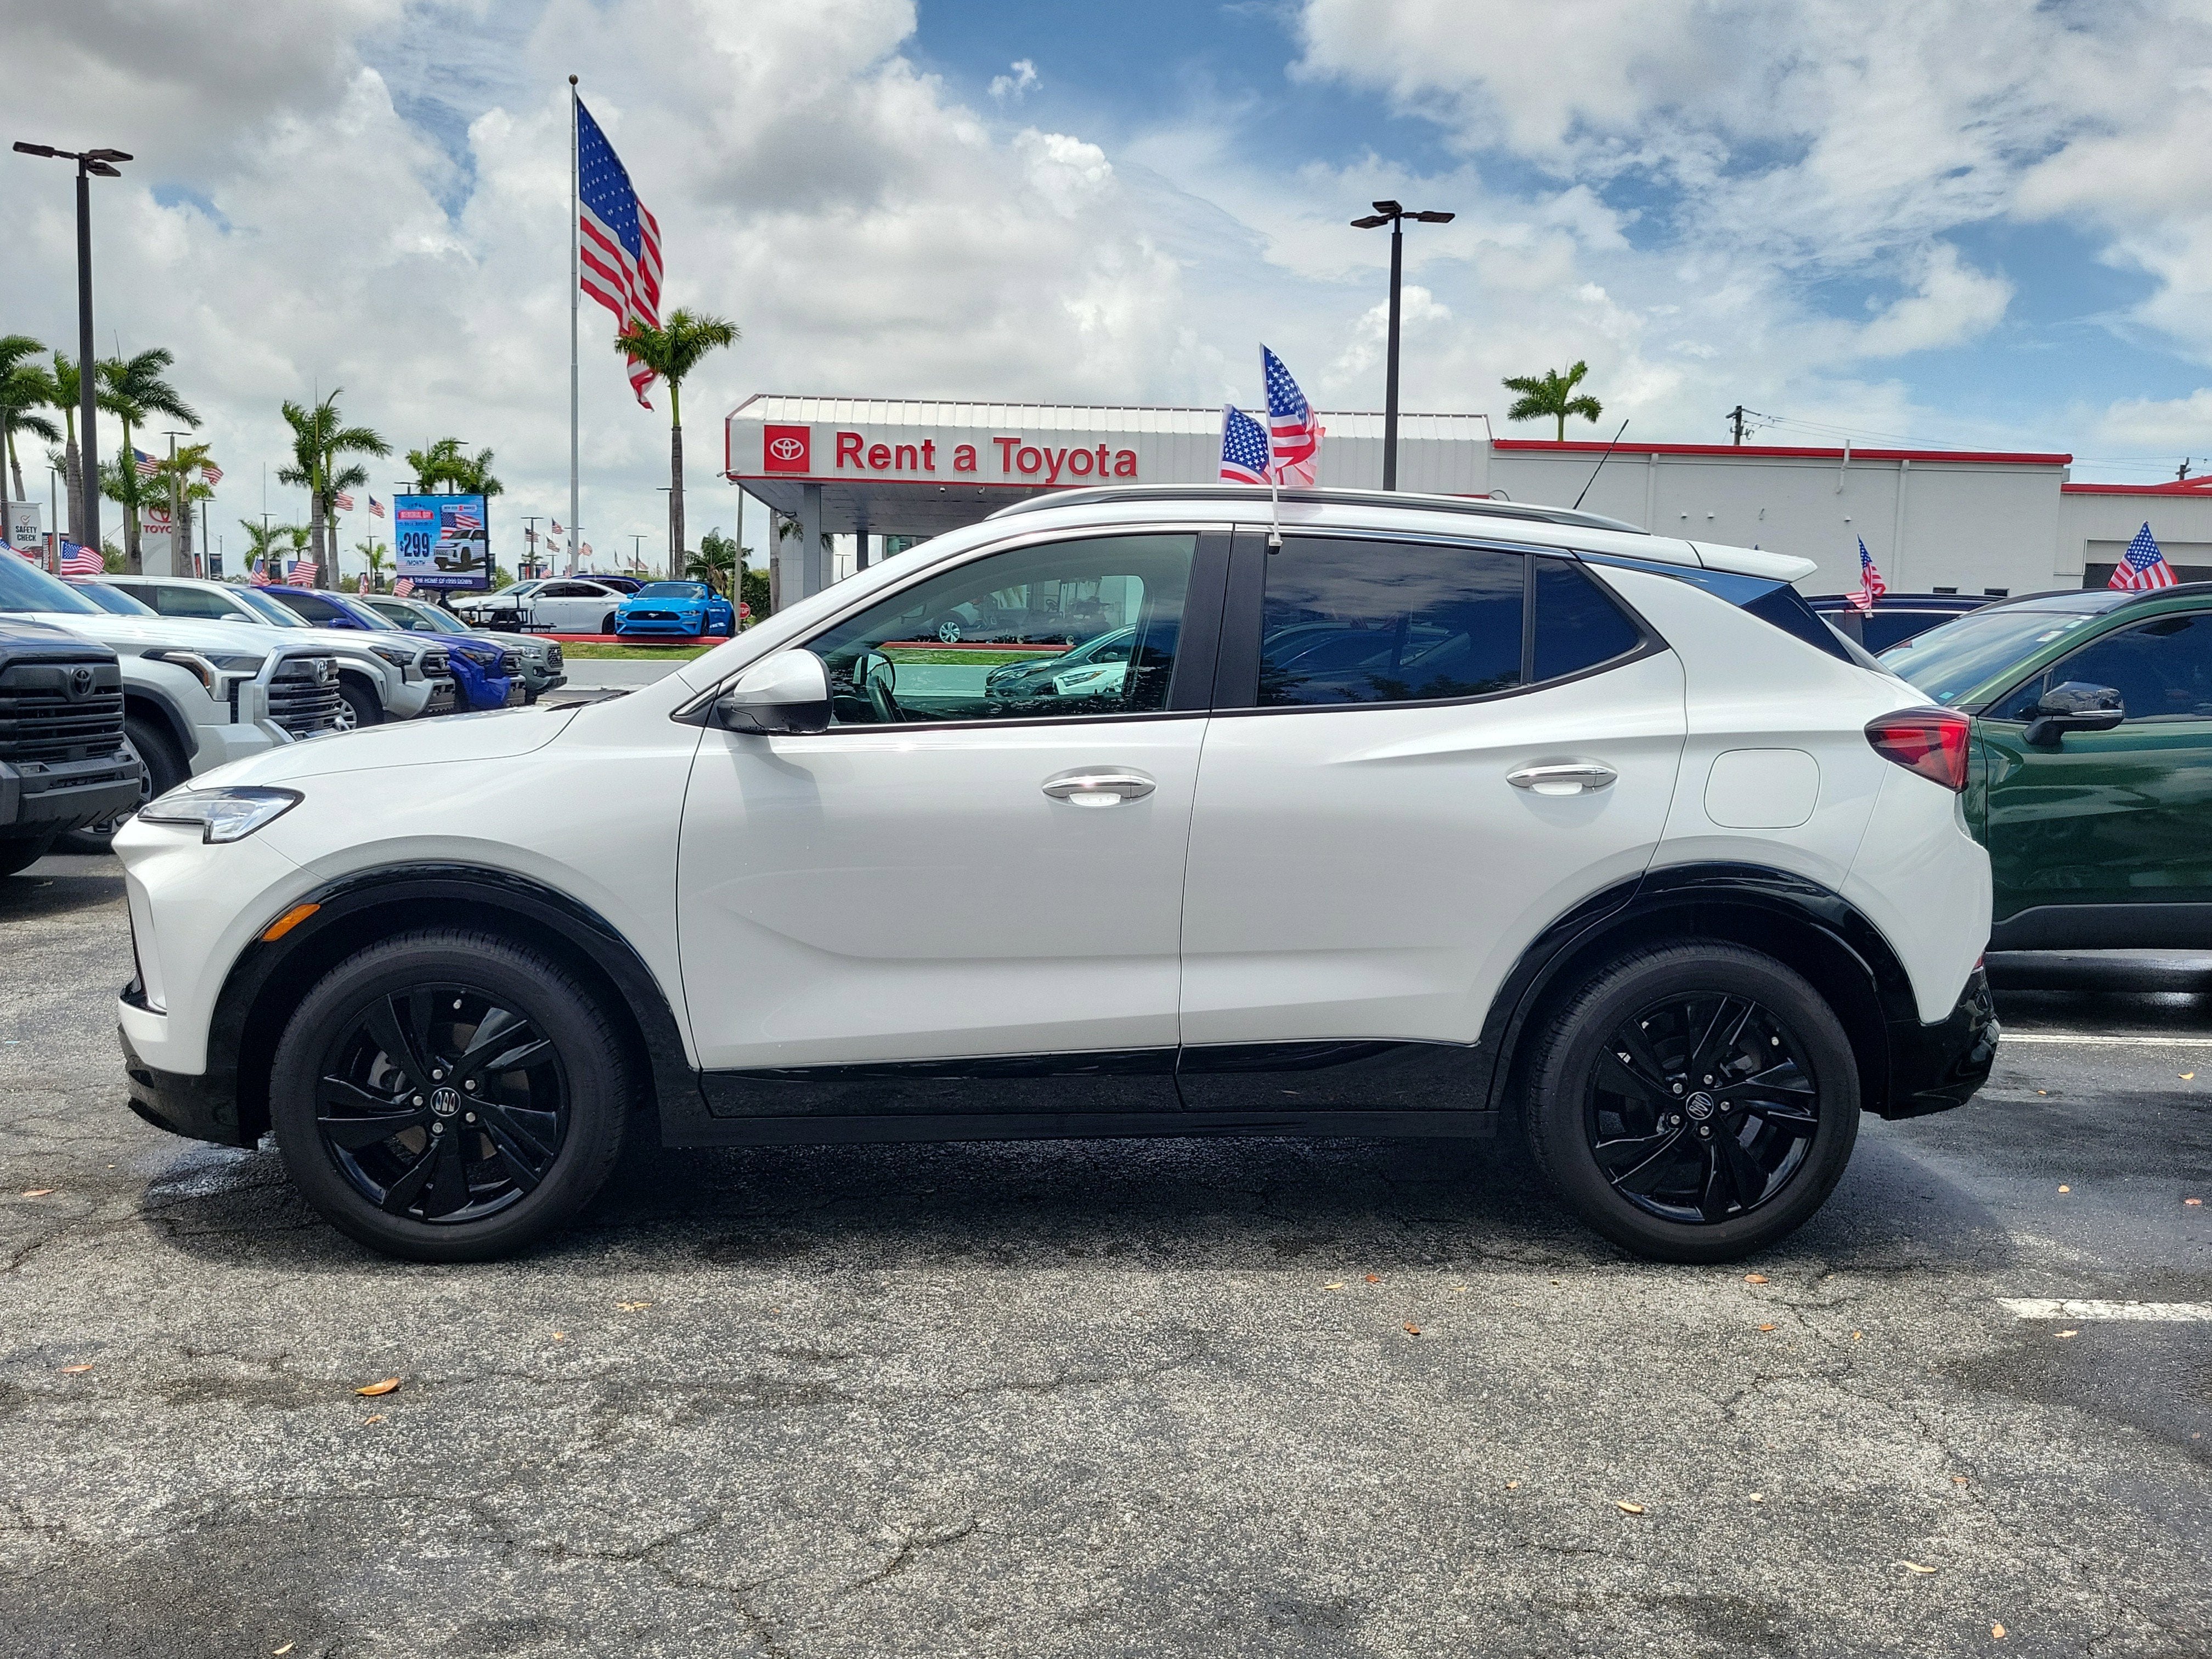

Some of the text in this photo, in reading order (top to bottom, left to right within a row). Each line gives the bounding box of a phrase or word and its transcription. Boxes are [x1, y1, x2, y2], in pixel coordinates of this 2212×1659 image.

[836, 431, 1138, 484] Rent a Toyota
[143, 524, 172, 534] TOYO
[17, 533, 37, 541] CHECK
